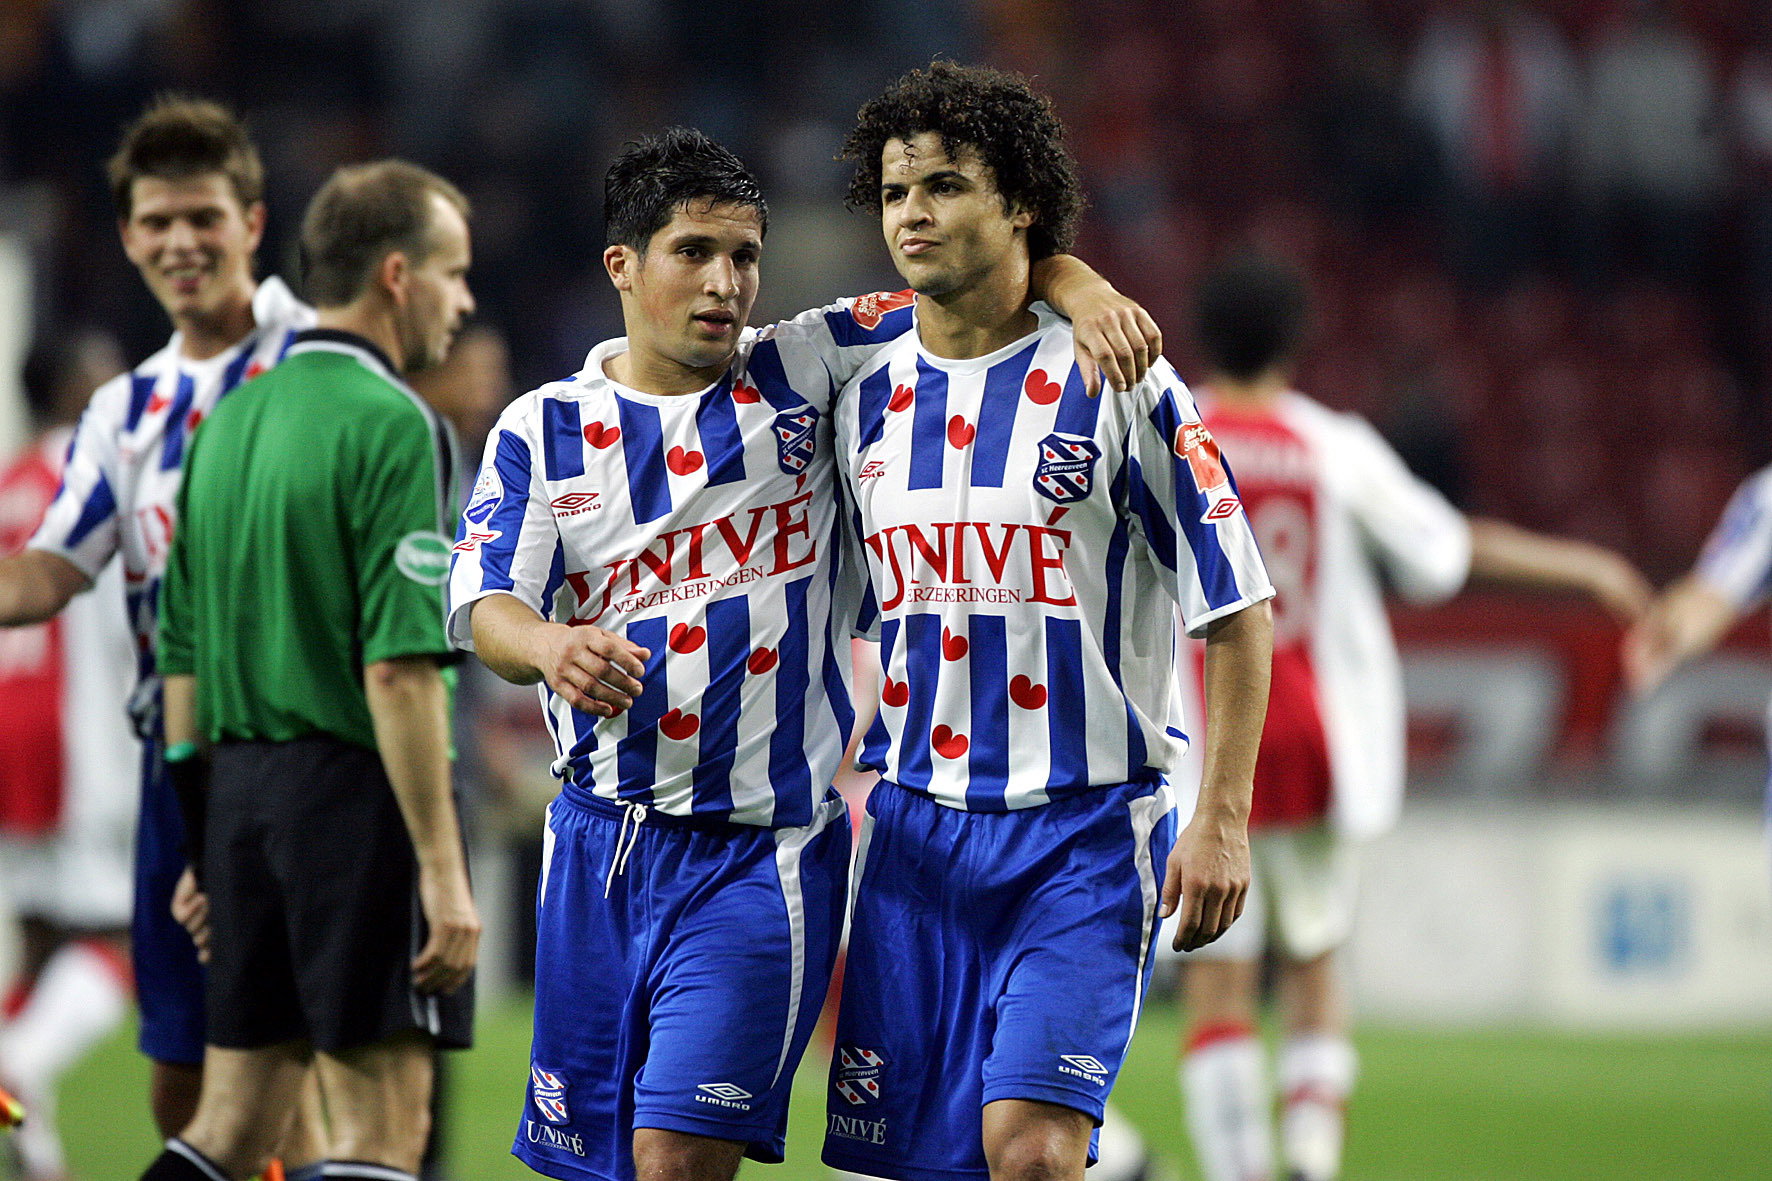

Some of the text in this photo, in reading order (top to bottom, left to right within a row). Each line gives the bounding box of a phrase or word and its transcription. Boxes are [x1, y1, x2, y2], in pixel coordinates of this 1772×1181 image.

[556, 503, 602, 518] MBRO
[565, 472, 816, 626] UNIVÉ
[613, 565, 765, 614] VERZEKERINGEN
[906, 586, 1021, 604] ERZEKERINGEN
[527, 1119, 586, 1157] UNIVÉ
